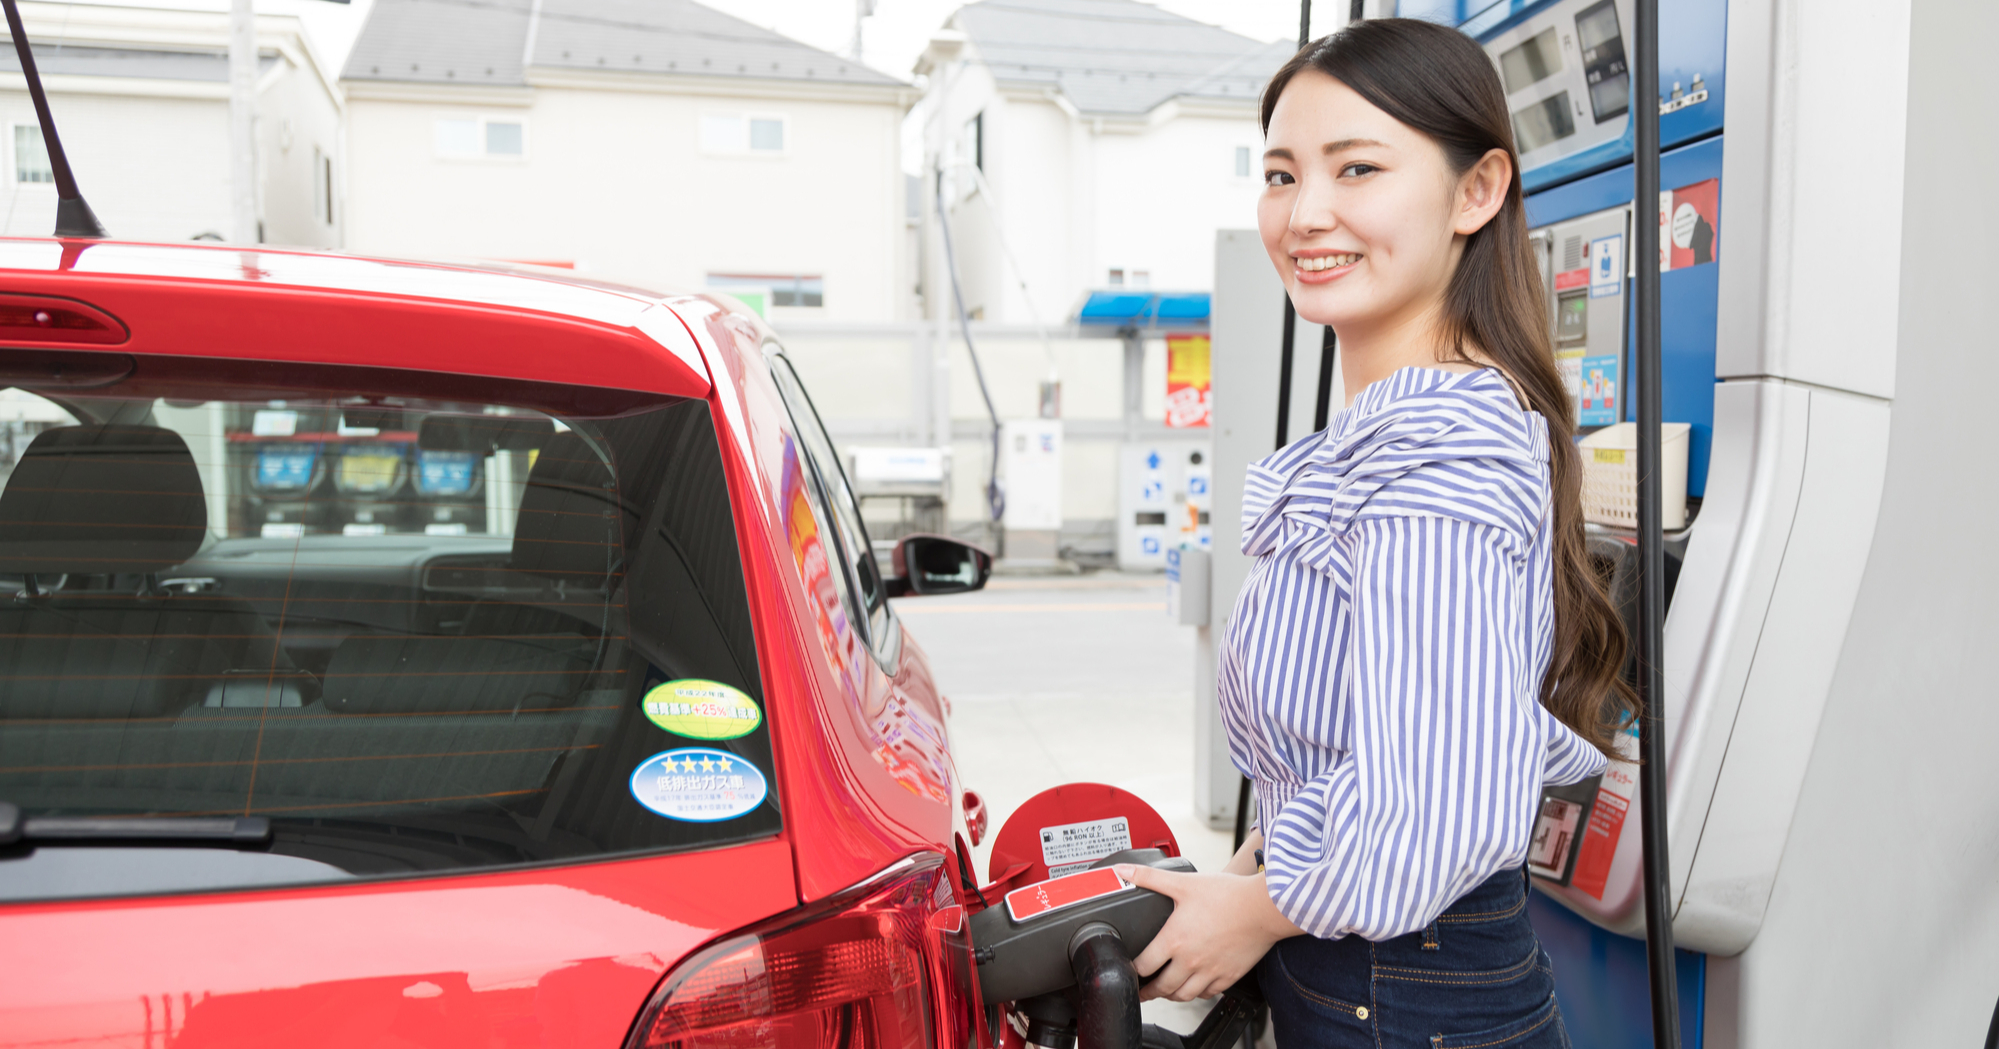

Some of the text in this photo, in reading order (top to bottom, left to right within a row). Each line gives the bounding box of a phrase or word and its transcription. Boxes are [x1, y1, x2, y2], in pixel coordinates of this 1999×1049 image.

[657, 774, 746, 792] 低排出ガス車
[1062, 824, 1102, 836] 無鉛ハイオク
[1074, 832, 1088, 841] RON
